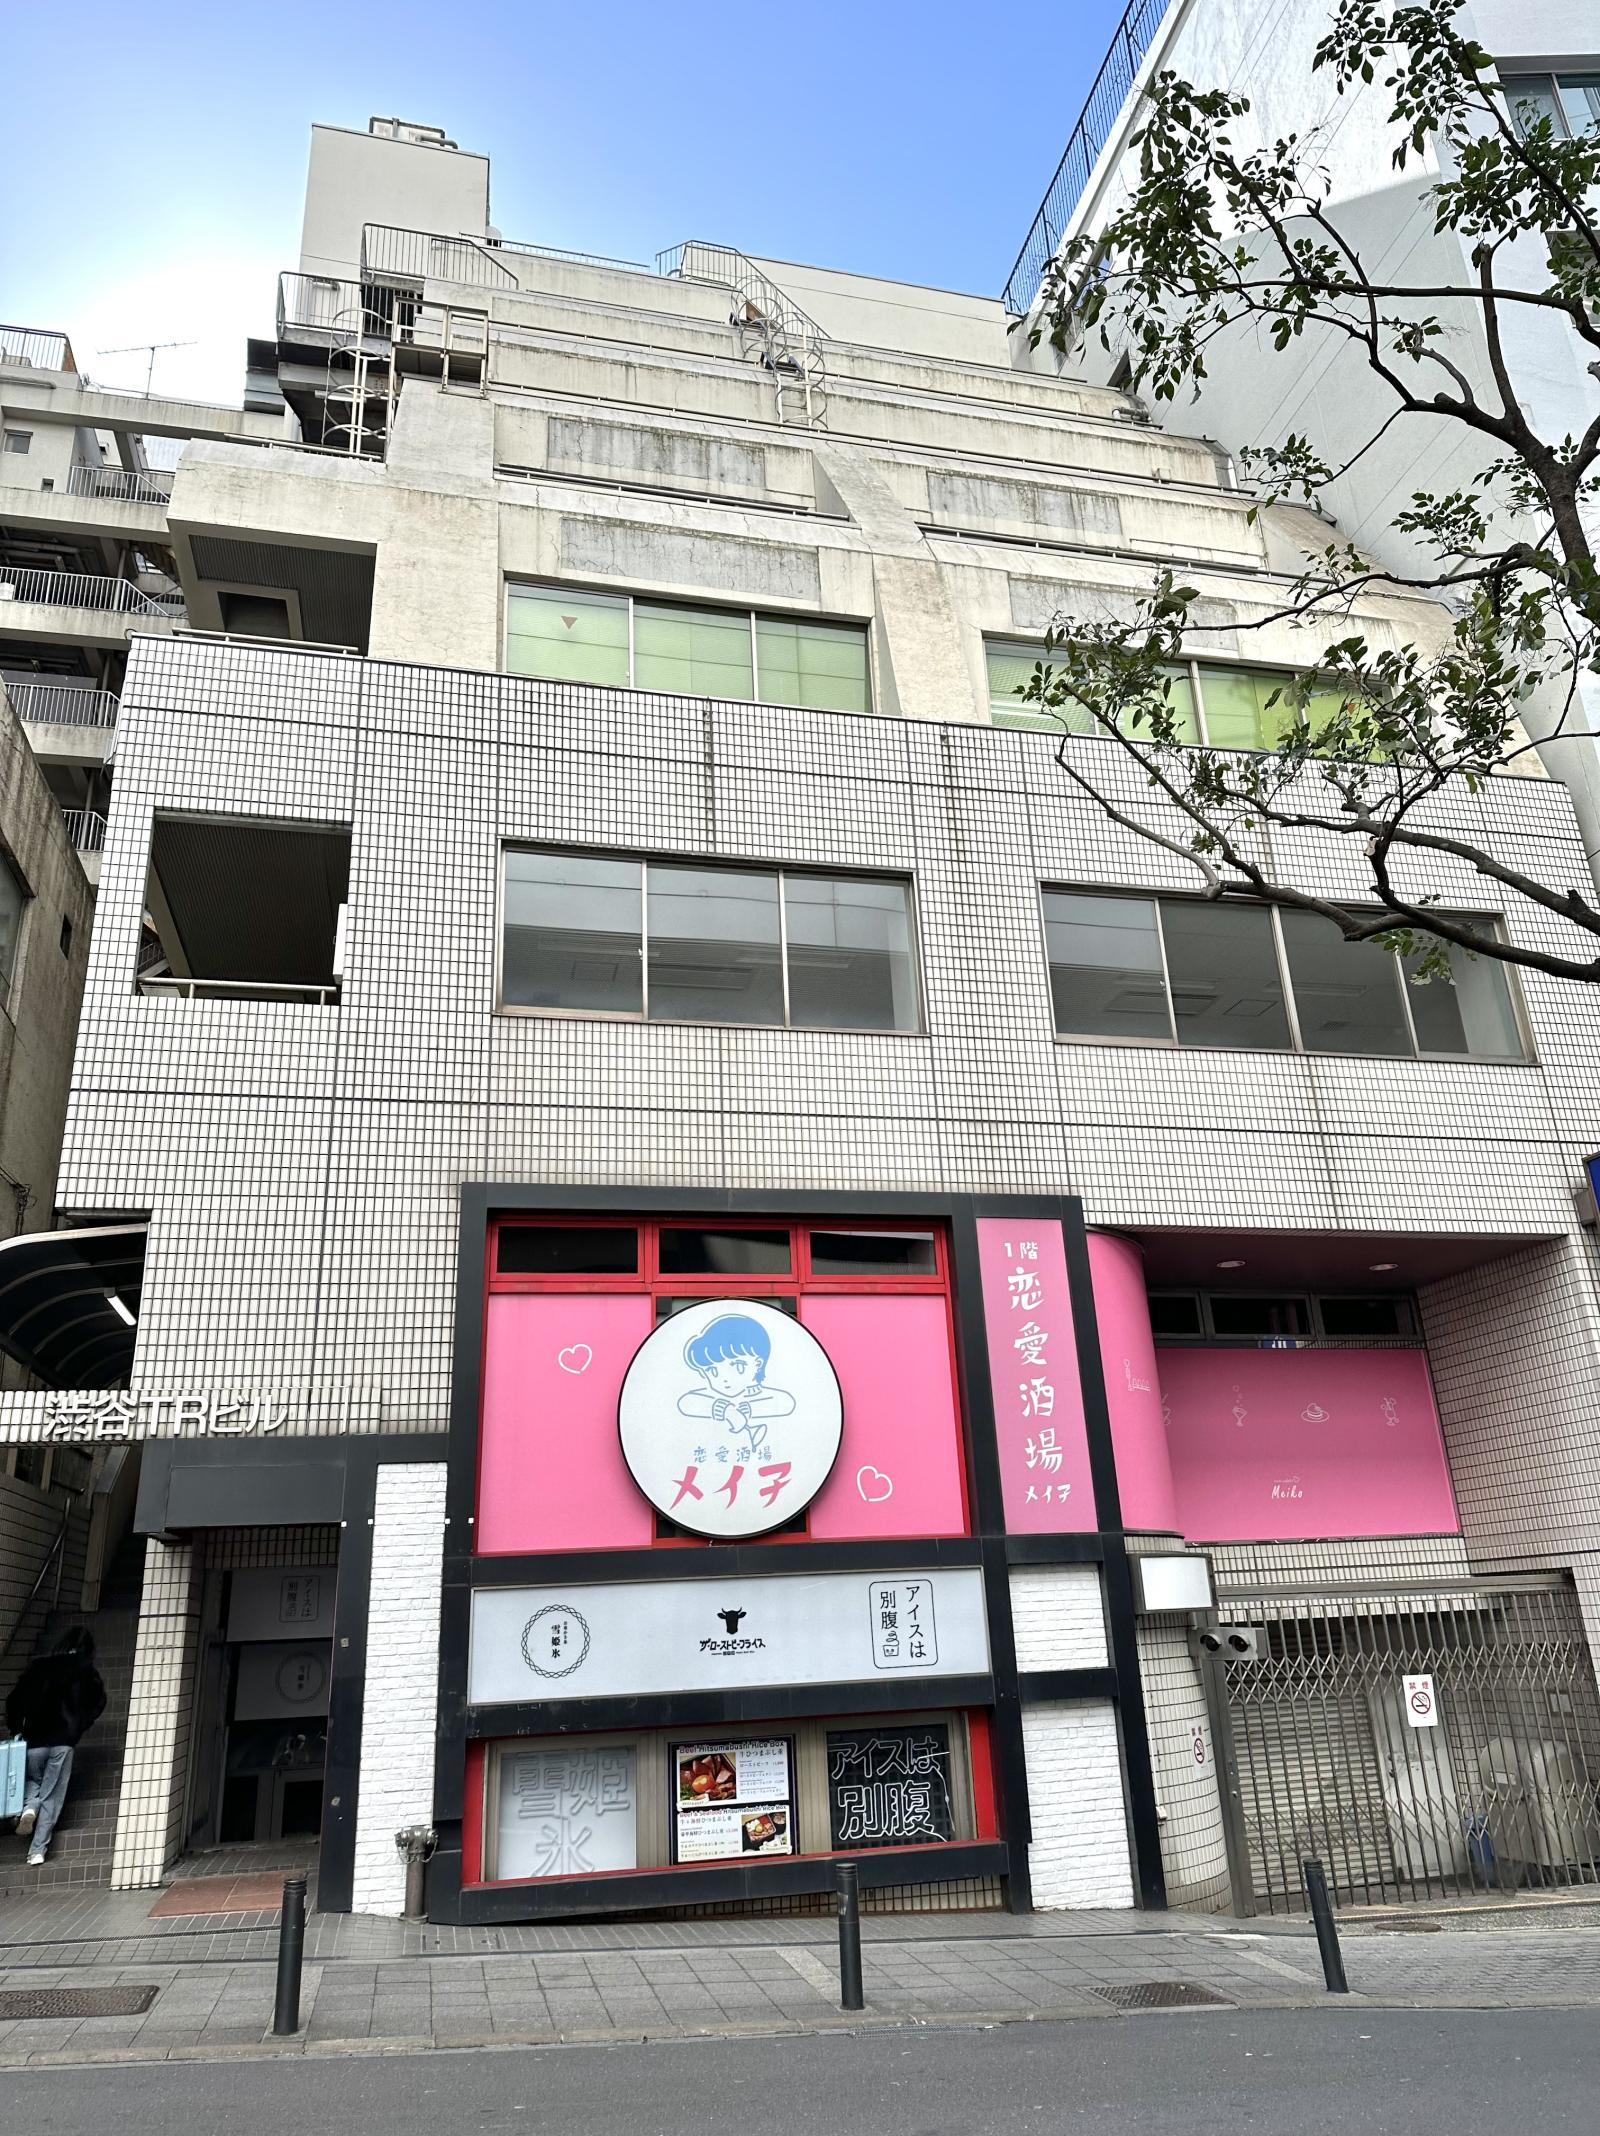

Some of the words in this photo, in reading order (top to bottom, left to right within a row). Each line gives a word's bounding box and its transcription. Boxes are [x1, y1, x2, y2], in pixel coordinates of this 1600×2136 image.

[1004, 1242, 1039, 1260] 1階
[1007, 1266, 1063, 1474] 恋愛酒場
[44, 1394, 288, 1437] 渋谷TRビル
[693, 1446, 773, 1463] 恋愛酒場
[669, 1461, 792, 1511] メイ子
[1024, 1483, 1072, 1504] メイ子
[1271, 1484, 1303, 1499] Meiko
[880, 1590, 898, 1630] 別腹
[906, 1585, 927, 1658] アイスは
[751, 1741, 768, 1749] Rice
[769, 1739, 784, 1748] Box
[828, 1736, 940, 1780] アイスは
[838, 1780, 935, 1840] 別腹
